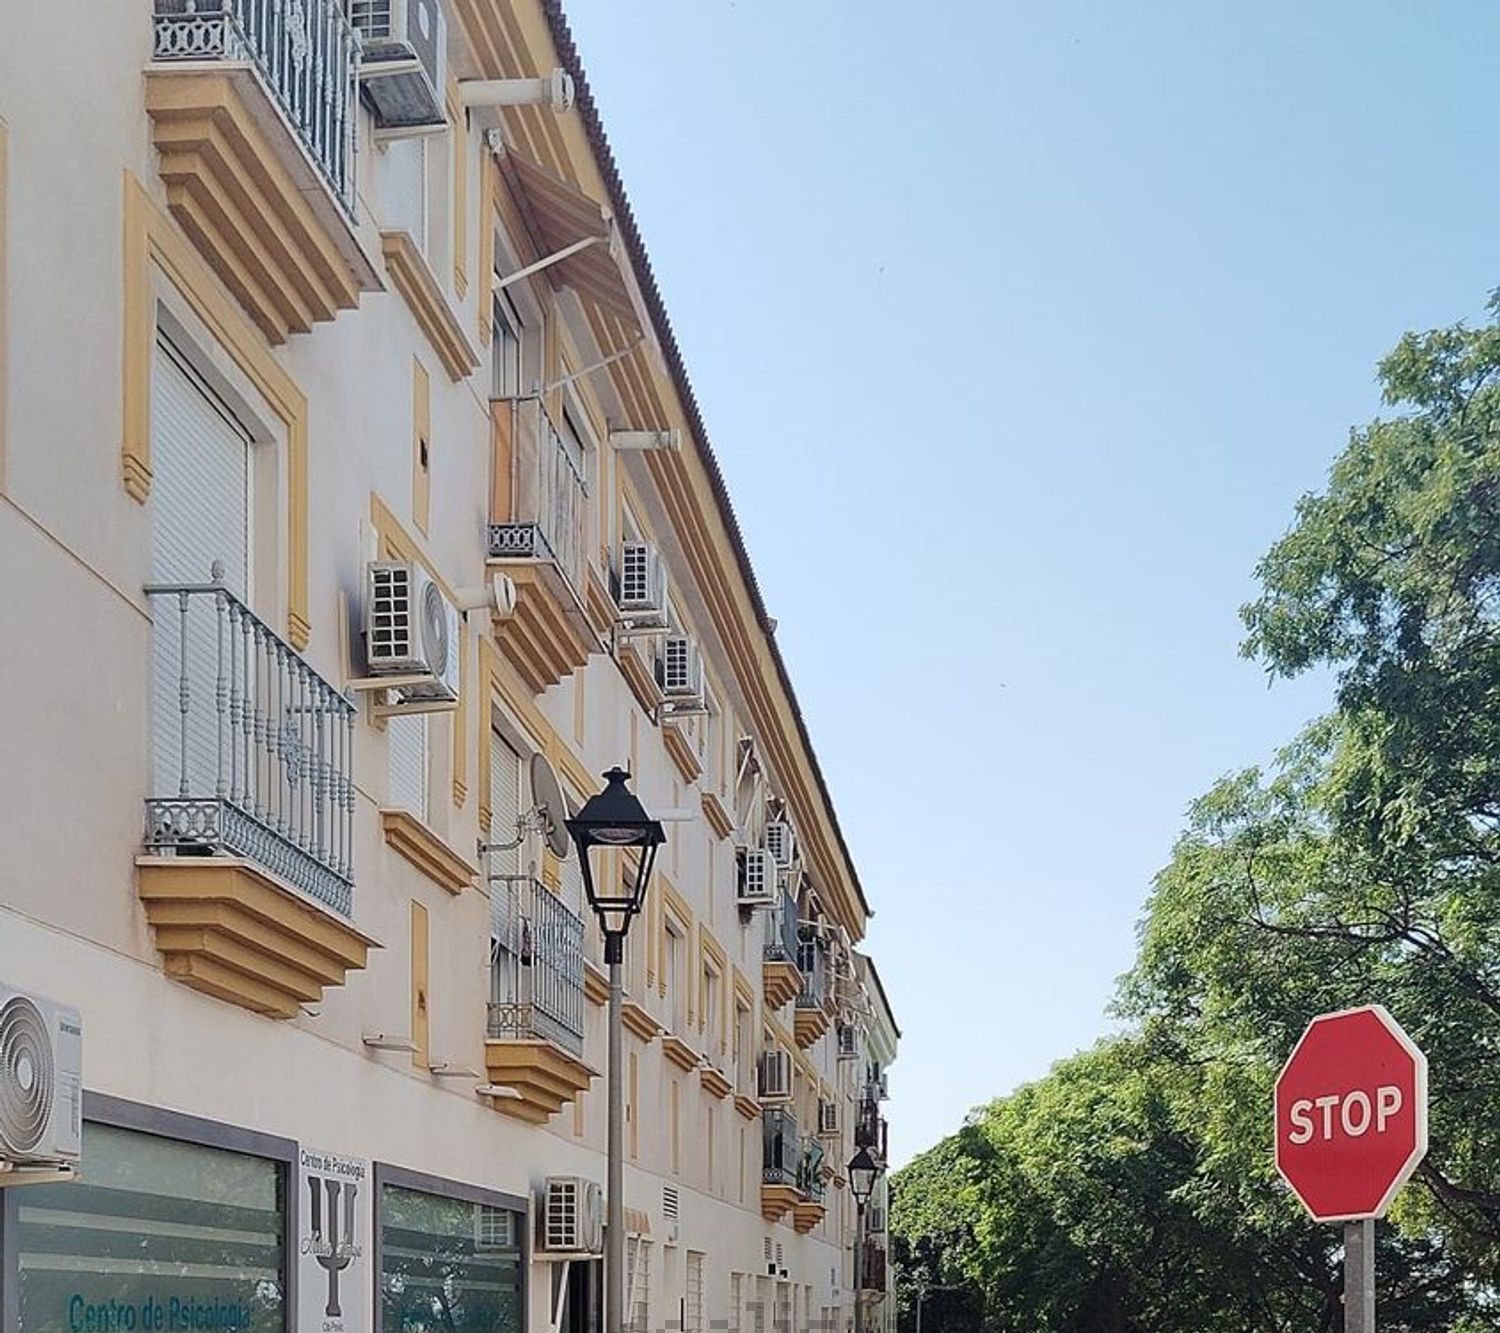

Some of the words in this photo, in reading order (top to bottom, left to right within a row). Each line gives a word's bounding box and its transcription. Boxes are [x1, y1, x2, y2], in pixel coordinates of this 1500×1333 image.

[1288, 1085, 1403, 1144] STOP
[69, 1293, 137, 1333] Centro
[142, 1296, 164, 1331] de
